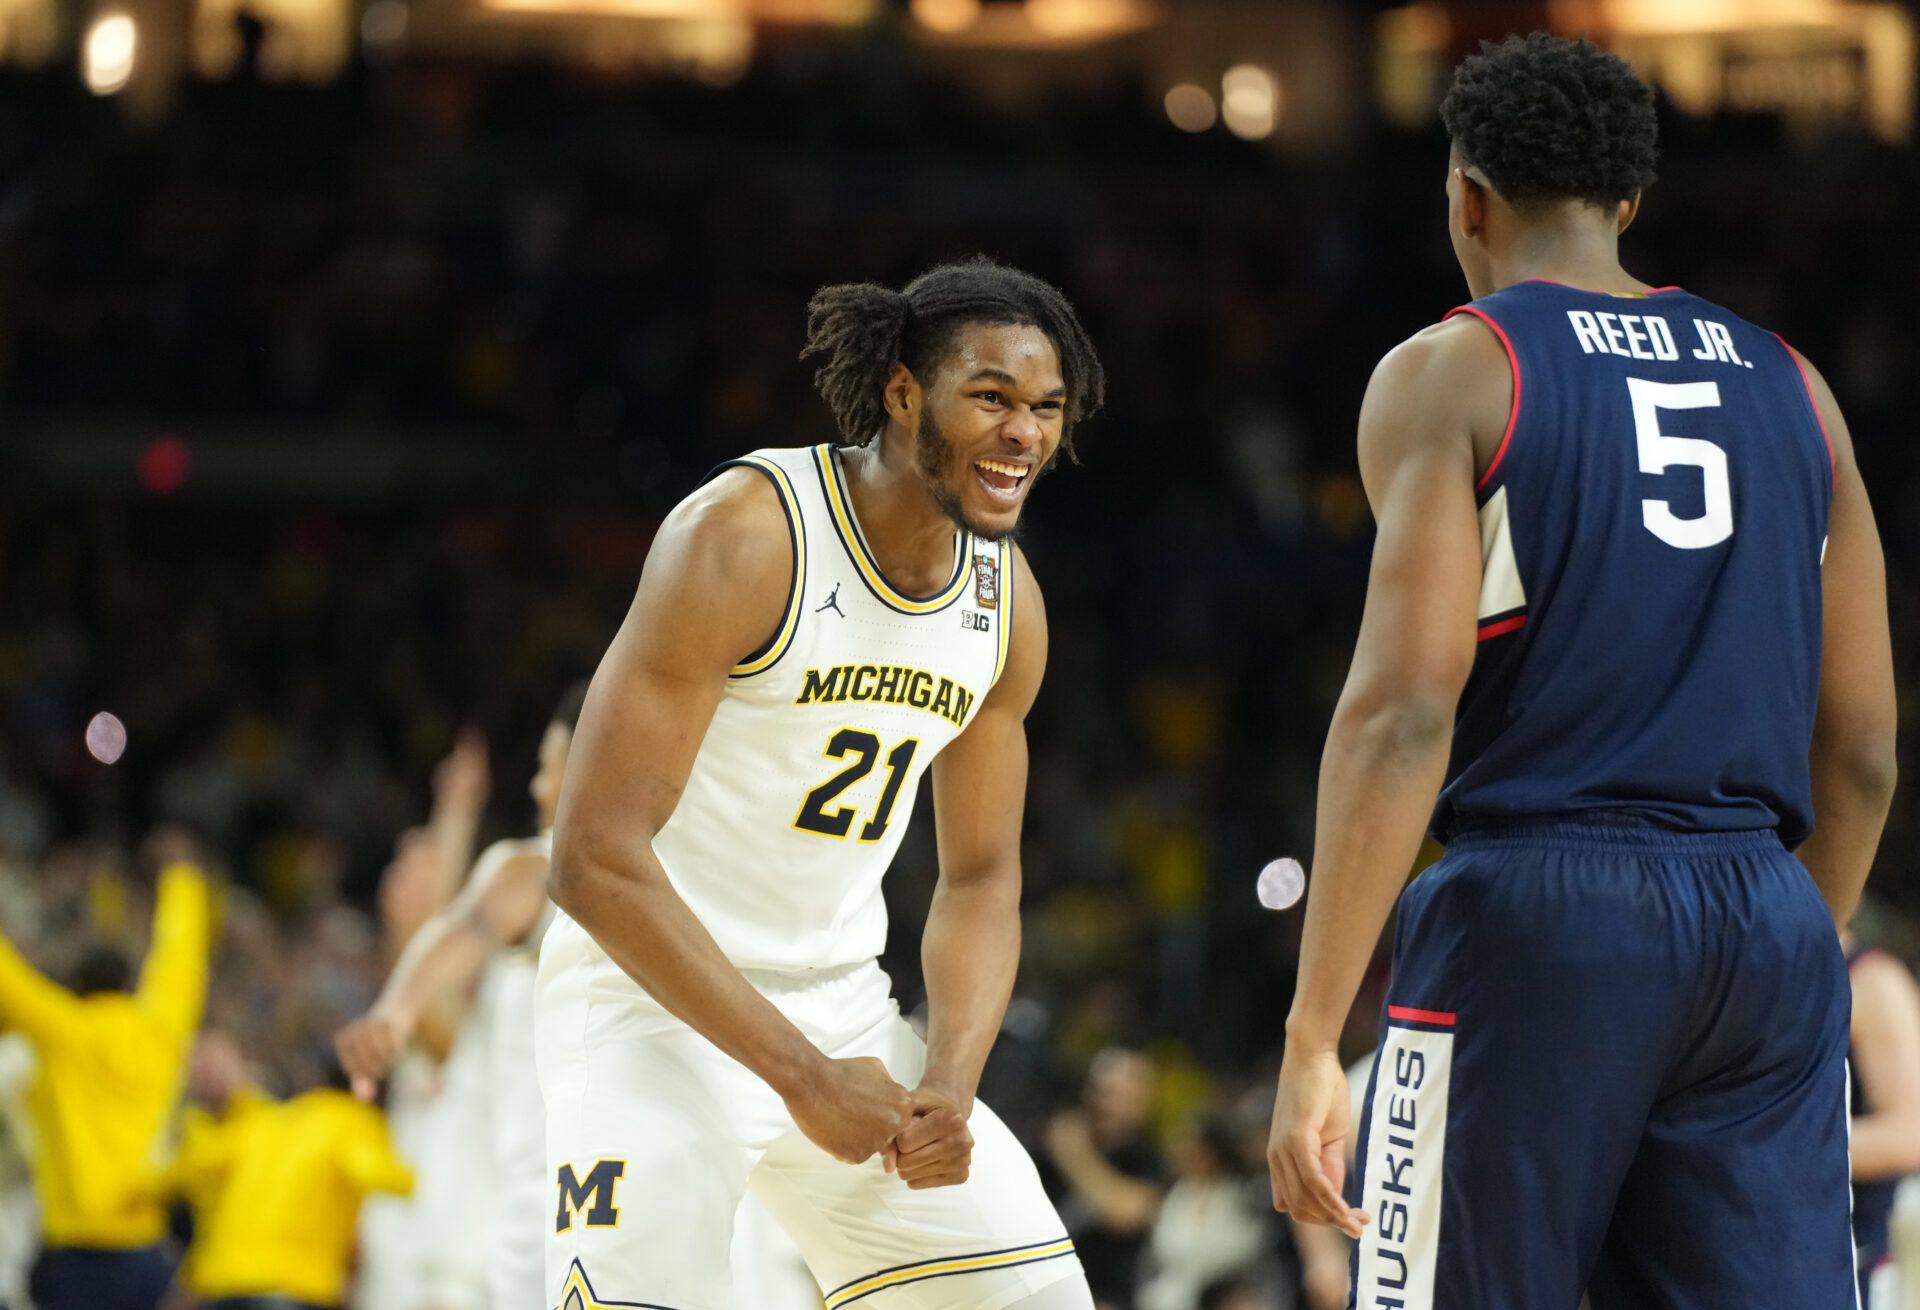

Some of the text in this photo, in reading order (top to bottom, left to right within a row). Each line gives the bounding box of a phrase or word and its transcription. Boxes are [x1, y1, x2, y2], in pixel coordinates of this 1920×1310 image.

[1566, 310, 1754, 368] REED JR.
[1625, 376, 1734, 550] 5
[794, 664, 974, 728] MICHIGAN
[791, 727, 919, 842] 21
[556, 1157, 627, 1235] M
